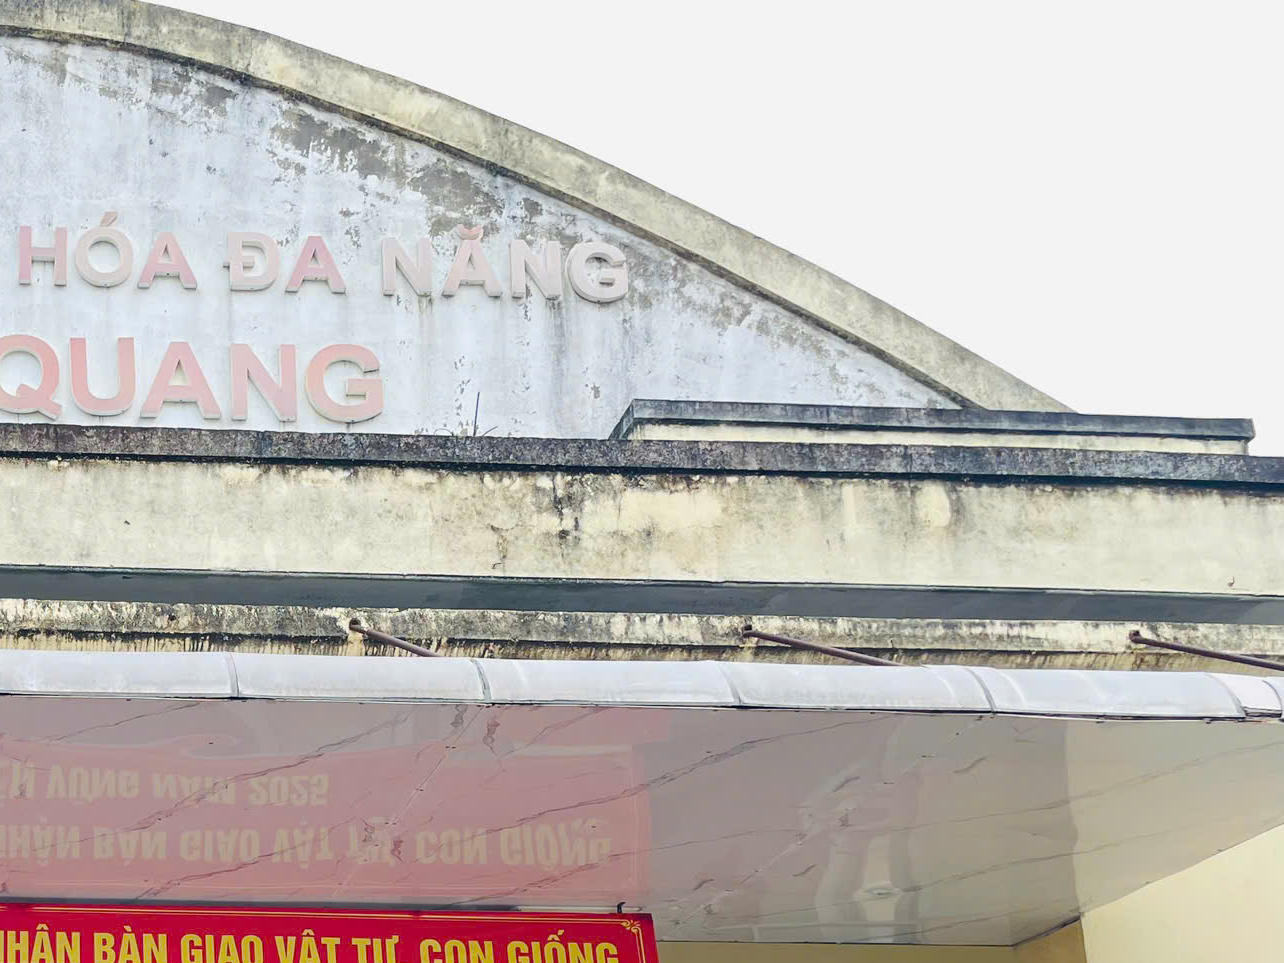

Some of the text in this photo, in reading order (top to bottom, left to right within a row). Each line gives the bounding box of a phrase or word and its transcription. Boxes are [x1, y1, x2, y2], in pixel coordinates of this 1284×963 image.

[18, 211, 198, 290] HÓA
[223, 231, 347, 294] ĐA
[381, 224, 628, 303] NĂNG
